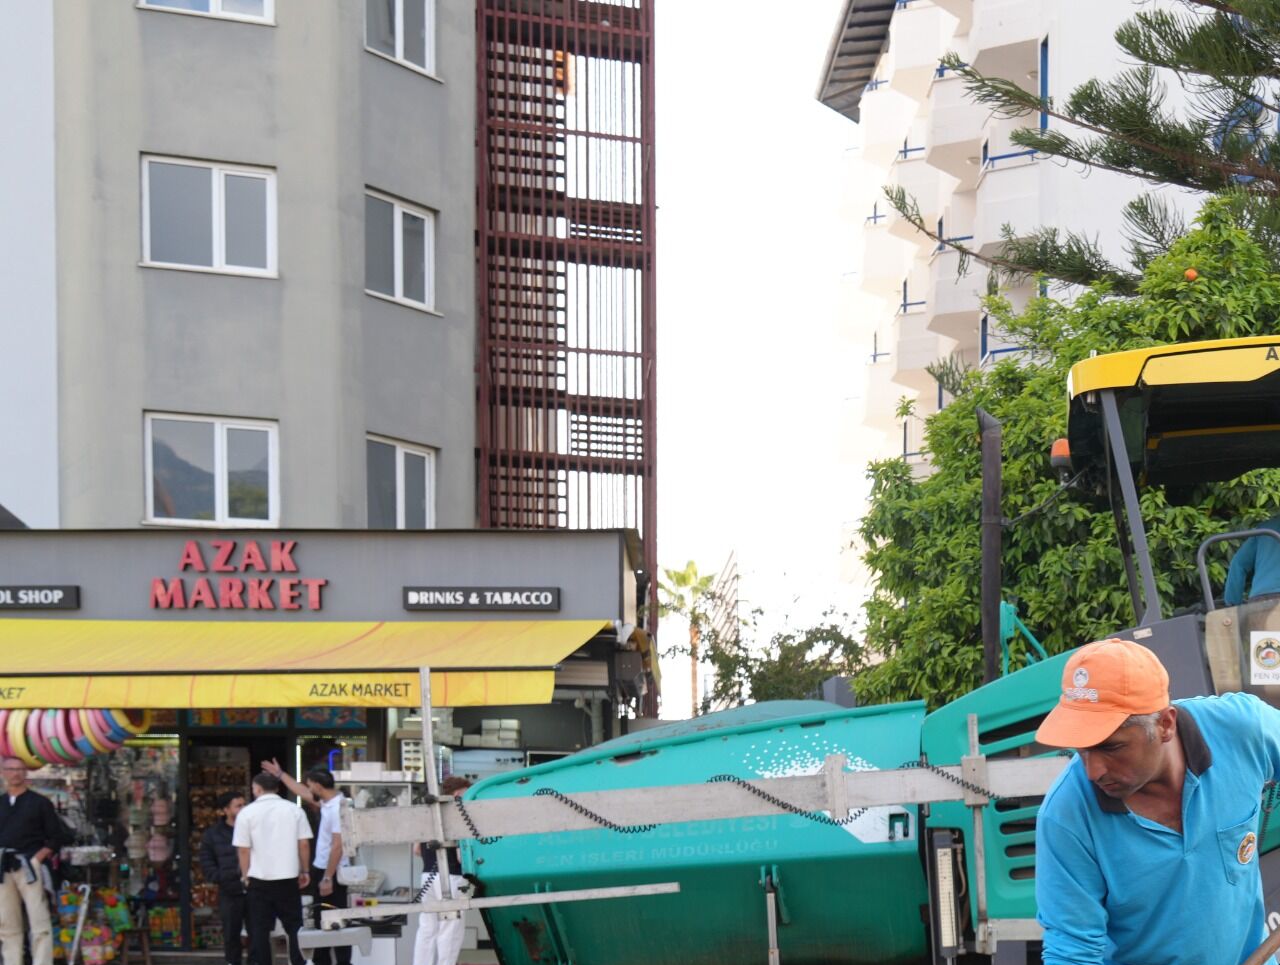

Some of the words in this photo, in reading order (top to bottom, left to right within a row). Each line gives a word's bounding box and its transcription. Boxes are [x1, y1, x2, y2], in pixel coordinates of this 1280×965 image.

[178, 540, 298, 572] AZAK
[18, 589, 64, 604] SHOP
[150, 577, 327, 611] MARKET
[408, 591, 464, 605] DRINKS
[468, 592, 480, 605] &
[484, 591, 553, 605] TABACCO
[1254, 672, 1270, 680] FEN
[309, 683, 349, 697] AZAK
[352, 682, 411, 697] MARKET
